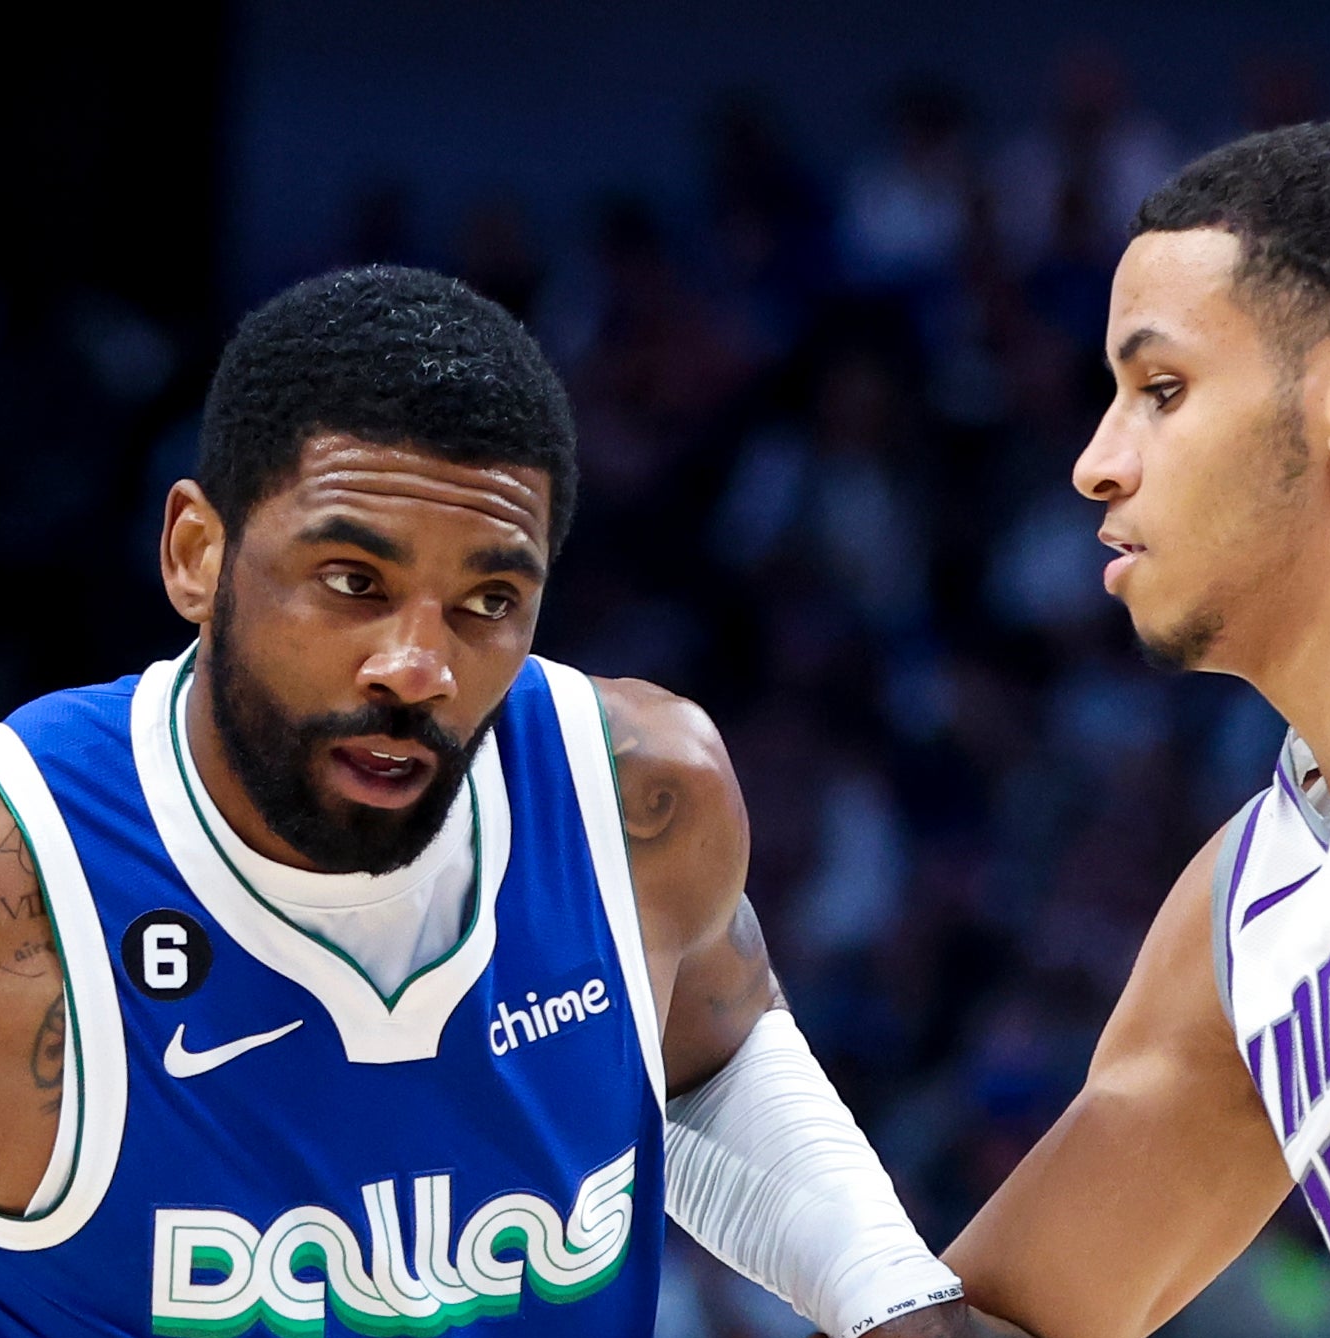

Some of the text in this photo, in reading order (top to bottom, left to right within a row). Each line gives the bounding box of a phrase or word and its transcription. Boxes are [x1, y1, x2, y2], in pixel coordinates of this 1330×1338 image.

[142, 923, 187, 989] 6
[490, 978, 610, 1056] chime
[851, 1316, 875, 1335] KAI
